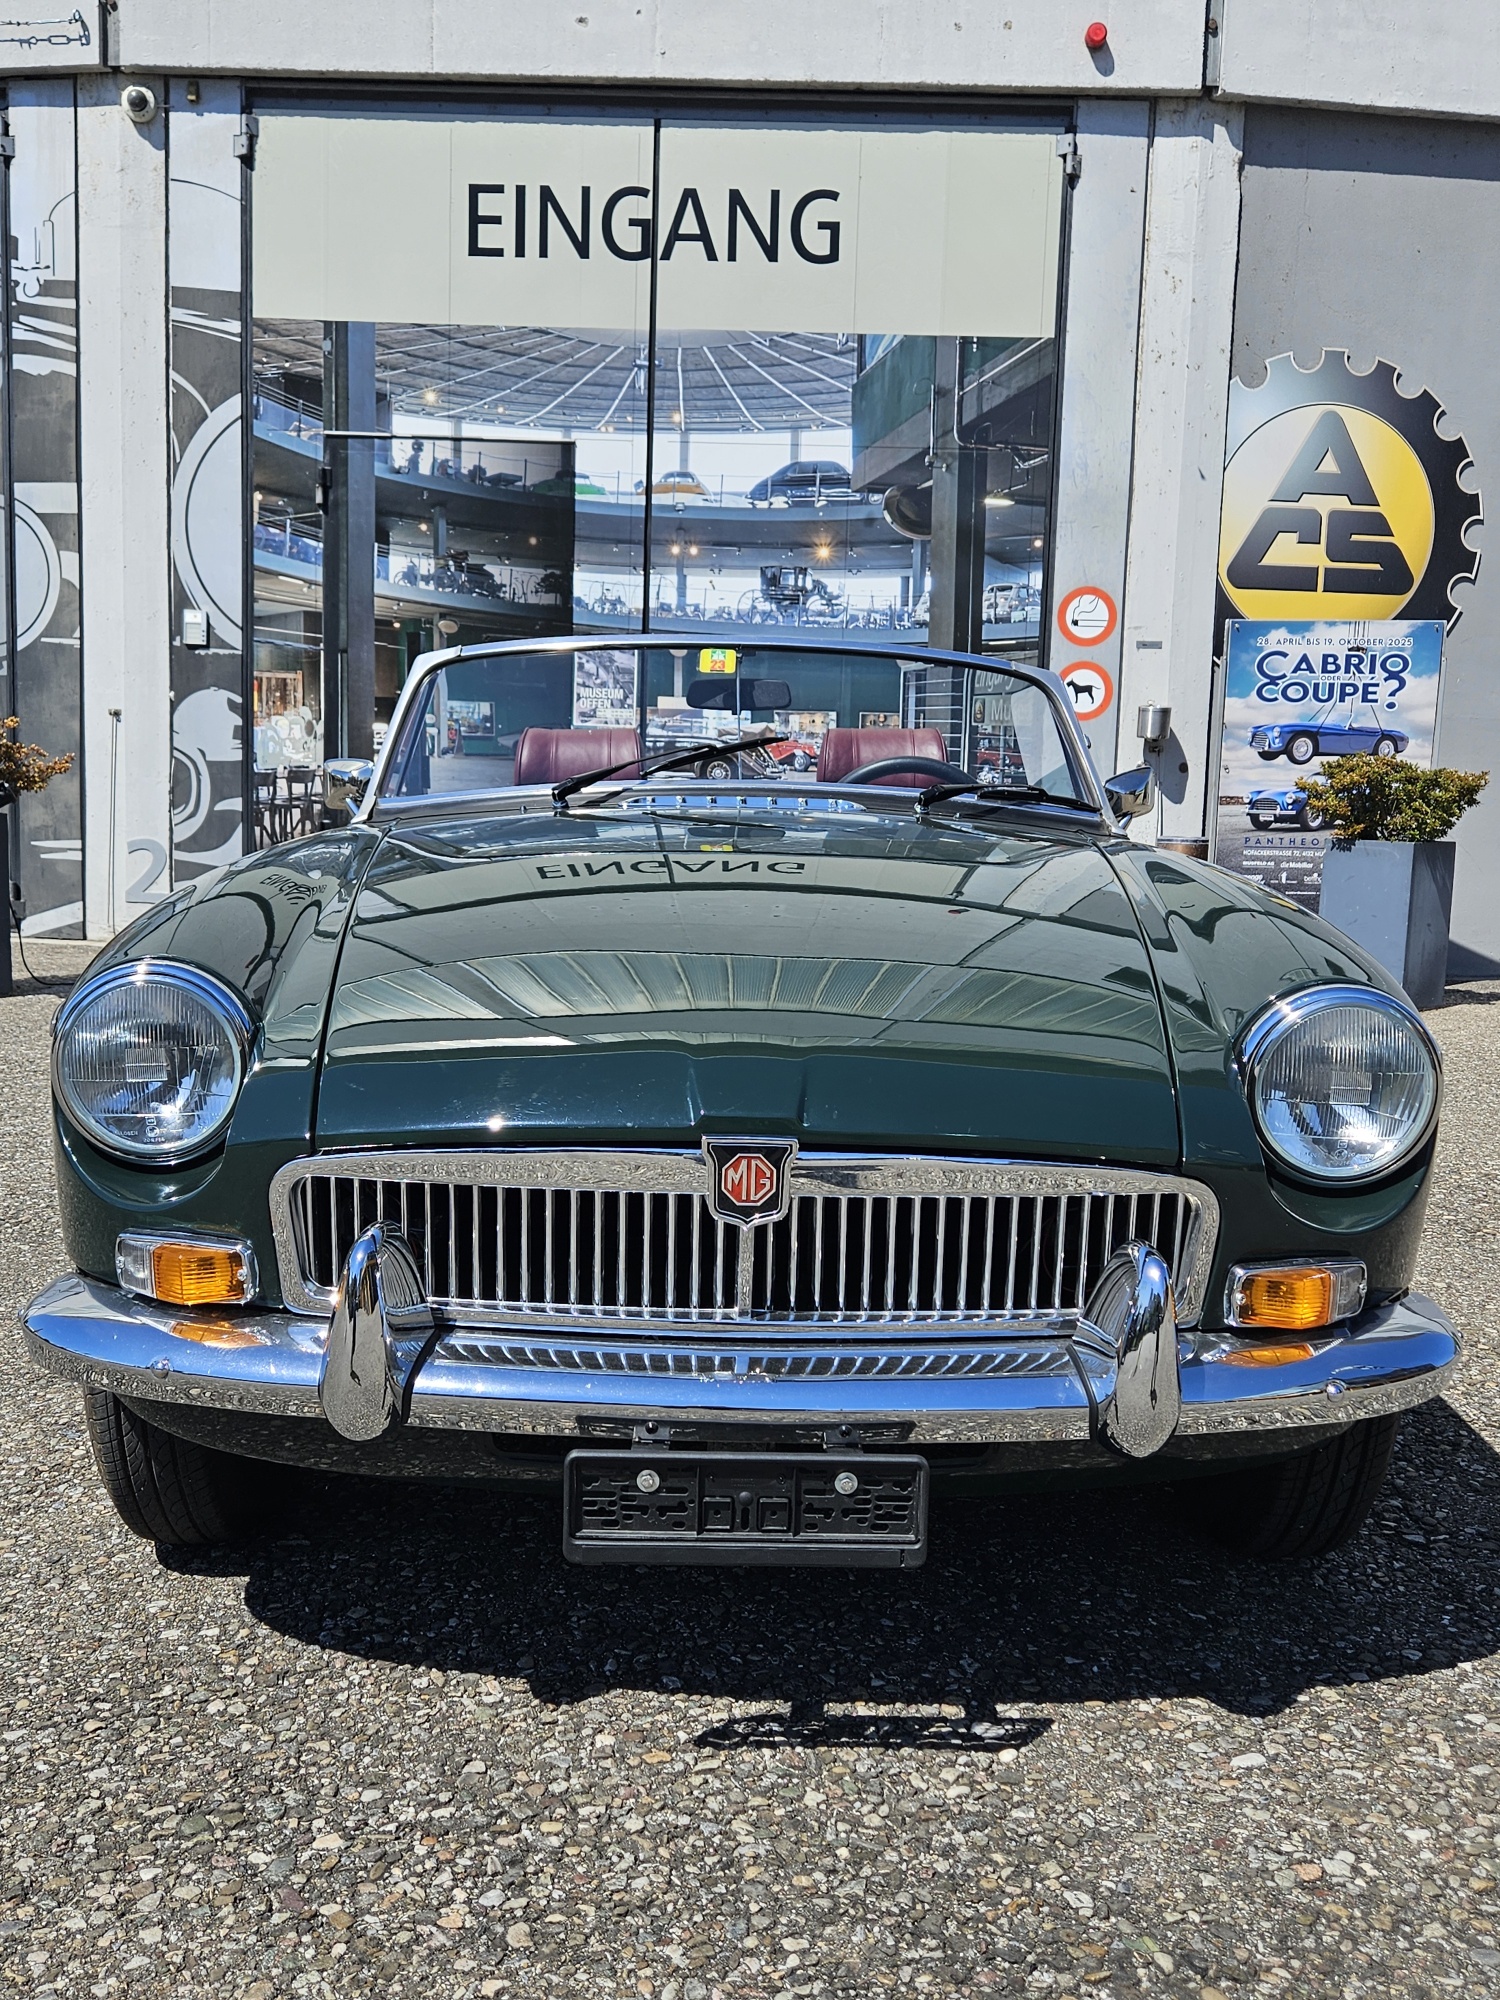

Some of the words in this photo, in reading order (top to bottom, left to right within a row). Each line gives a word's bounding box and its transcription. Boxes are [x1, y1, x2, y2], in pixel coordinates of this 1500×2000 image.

[468, 183, 841, 265] EINGANG
[1257, 637, 1272, 646] 28.
[1276, 638, 1302, 646] APRIL
[1306, 638, 1320, 646] BIS
[1324, 638, 1335, 646] 19.
[1338, 638, 1384, 646] OKTOBER
[1388, 638, 1413, 646] 2025
[710, 660, 726, 670] 23
[1256, 650, 1410, 681] CABRIO
[580, 688, 624, 700] MUSEUM
[580, 698, 612, 709] OFFEN
[1244, 836, 1320, 846] PANTHEO
[727, 1158, 771, 1201] MG
